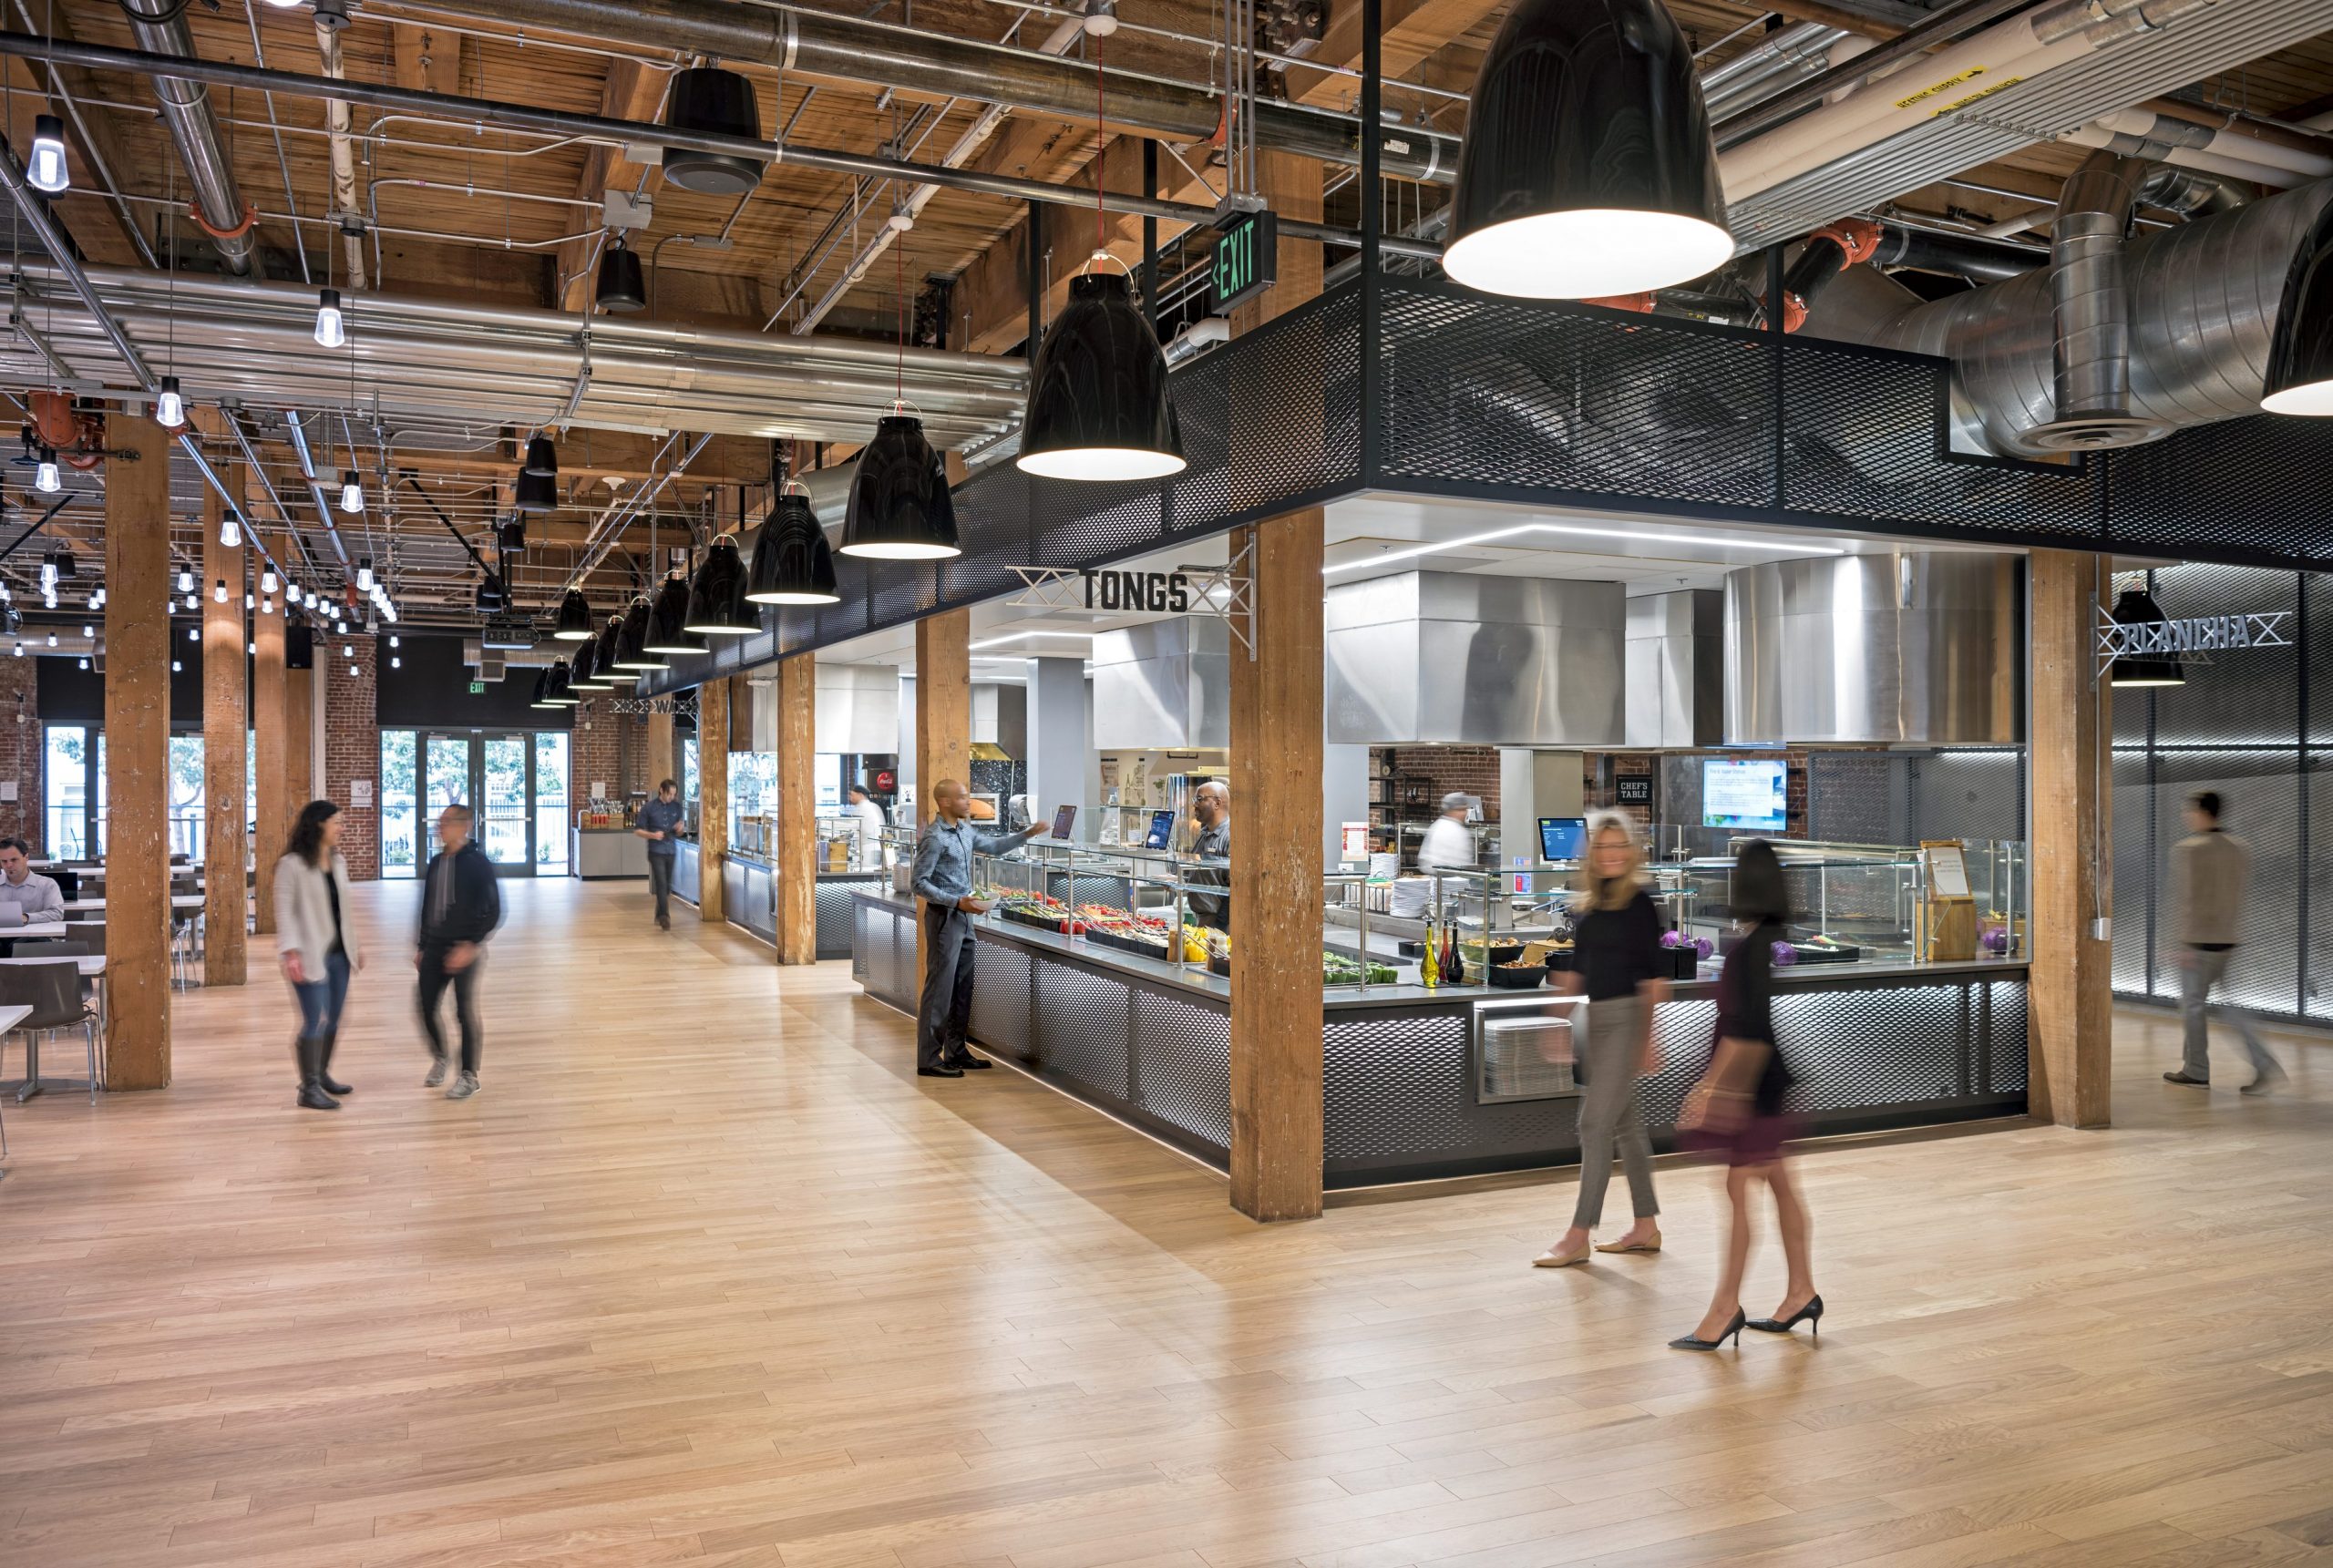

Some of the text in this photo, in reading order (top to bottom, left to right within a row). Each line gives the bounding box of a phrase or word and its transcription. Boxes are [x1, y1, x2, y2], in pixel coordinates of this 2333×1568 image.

[1220, 220, 1254, 300] EXIT
[1079, 569, 1187, 612] TONGS
[2123, 614, 2252, 654] PLANCHA
[470, 682, 485, 693] EXIT
[1621, 782, 1648, 790] CHEF'S
[1621, 790, 1648, 799] TABLE
